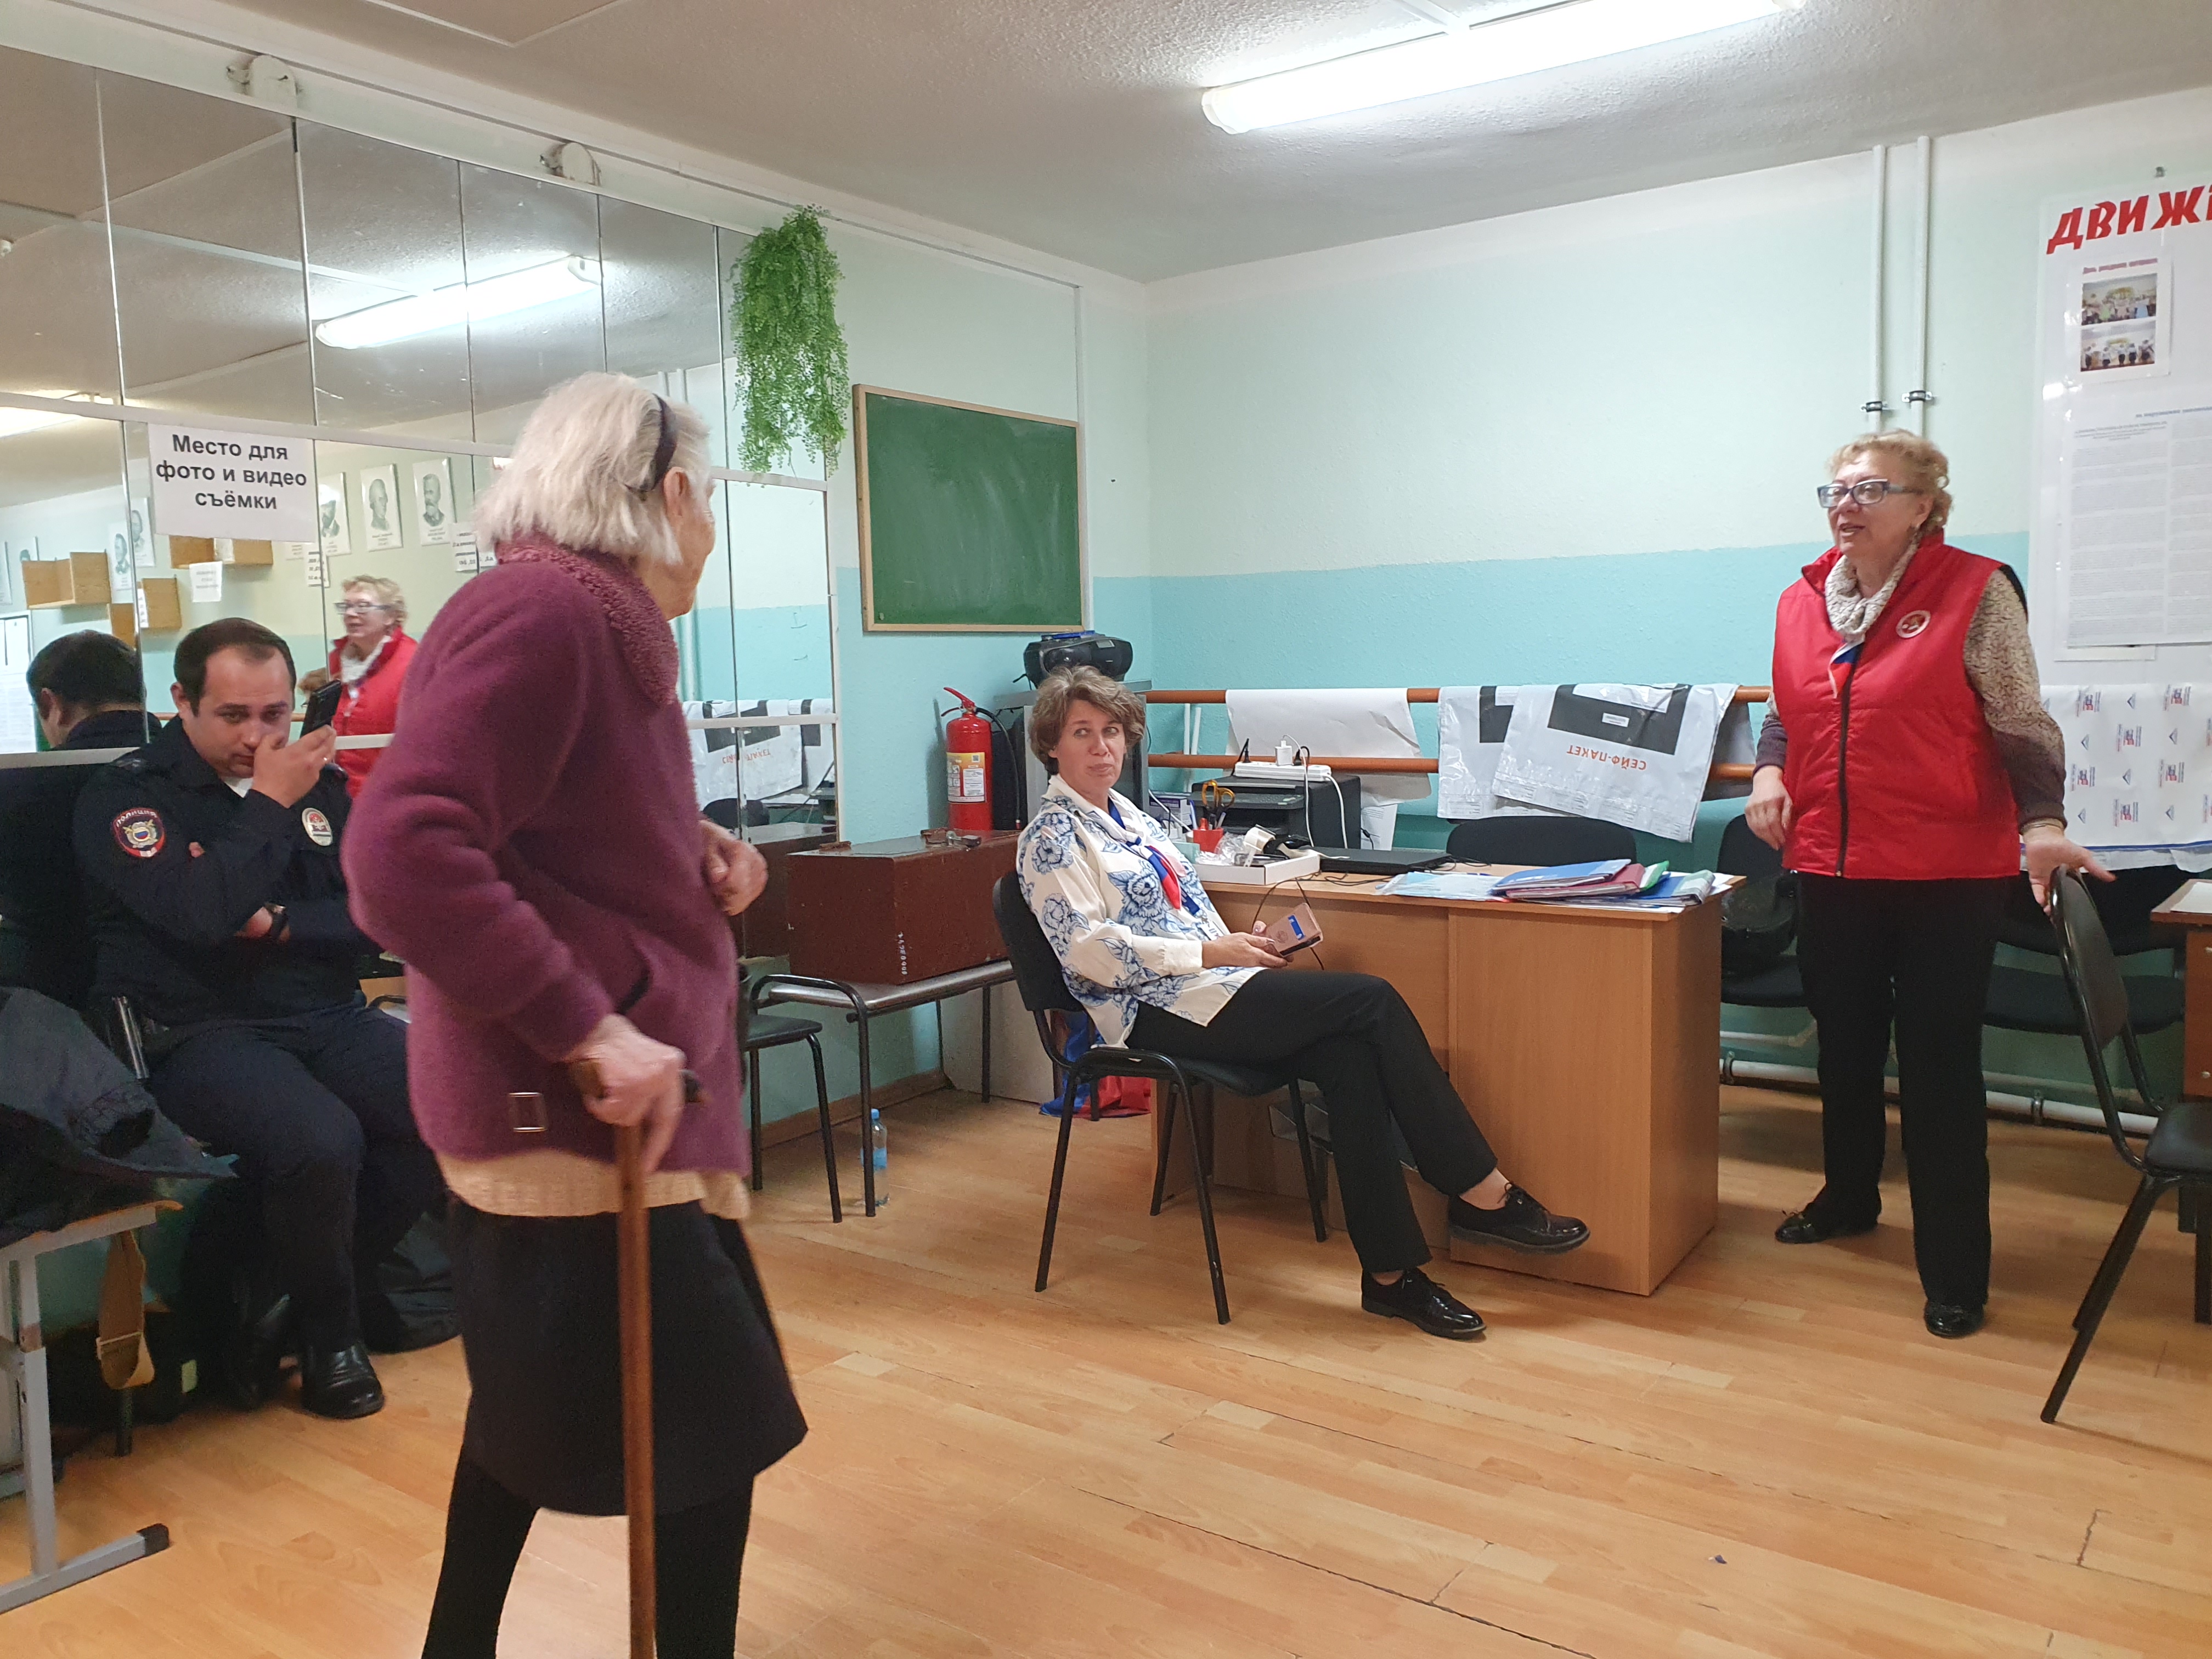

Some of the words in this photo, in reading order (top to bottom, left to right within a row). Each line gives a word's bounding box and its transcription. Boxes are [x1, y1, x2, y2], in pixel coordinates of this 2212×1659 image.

[2046, 185, 2212, 255] ДВИЖ
[172, 434, 241, 456] Место
[249, 445, 288, 461] для
[156, 460, 215, 482] фото
[223, 469, 235, 482] и
[243, 470, 307, 487] видео
[195, 490, 276, 509] съёмки
[1566, 745, 1646, 770] СЕЙФ-ПАКЕТ
[116, 810, 157, 827] ПОЛИЦИЯ
